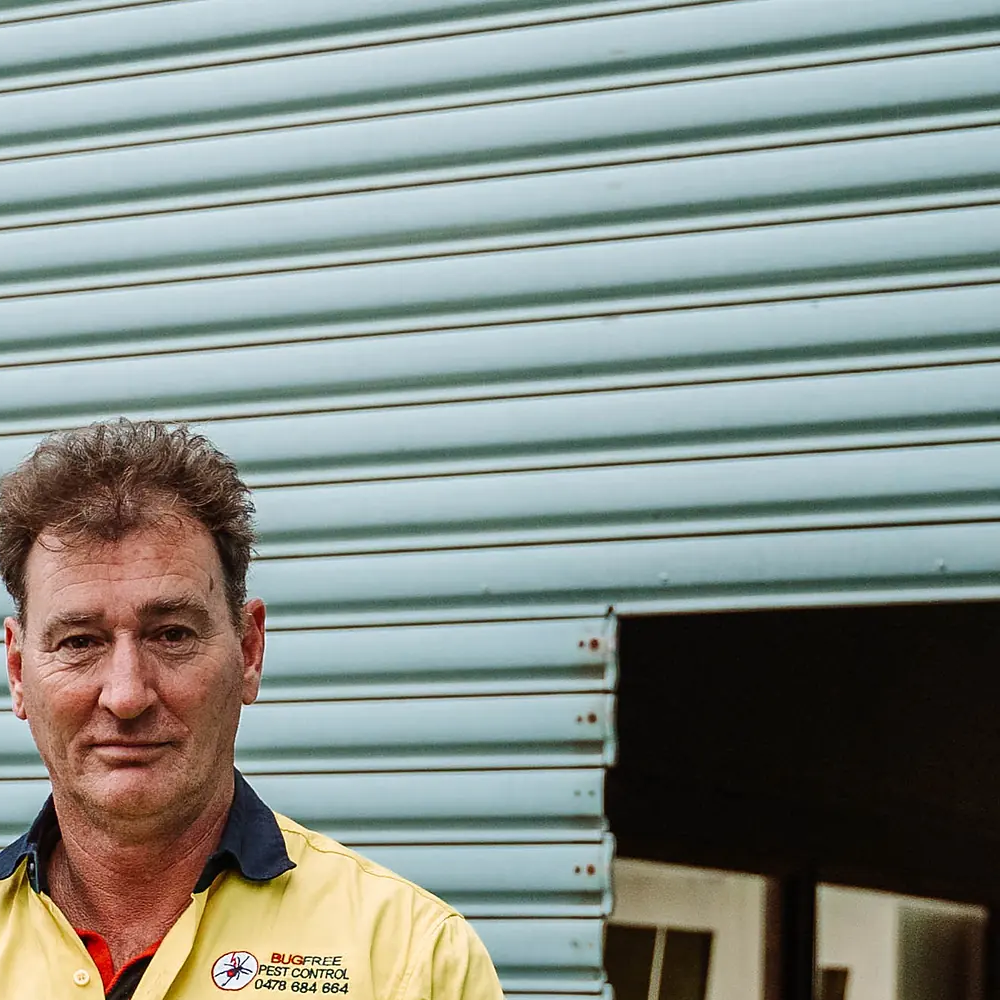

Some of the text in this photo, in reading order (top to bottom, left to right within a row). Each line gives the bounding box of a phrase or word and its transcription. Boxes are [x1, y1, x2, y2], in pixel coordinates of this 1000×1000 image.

[271, 952, 342, 966] BUGFREE
[258, 964, 349, 980] PEST CONTROL
[254, 978, 349, 994] 0478 684 664
